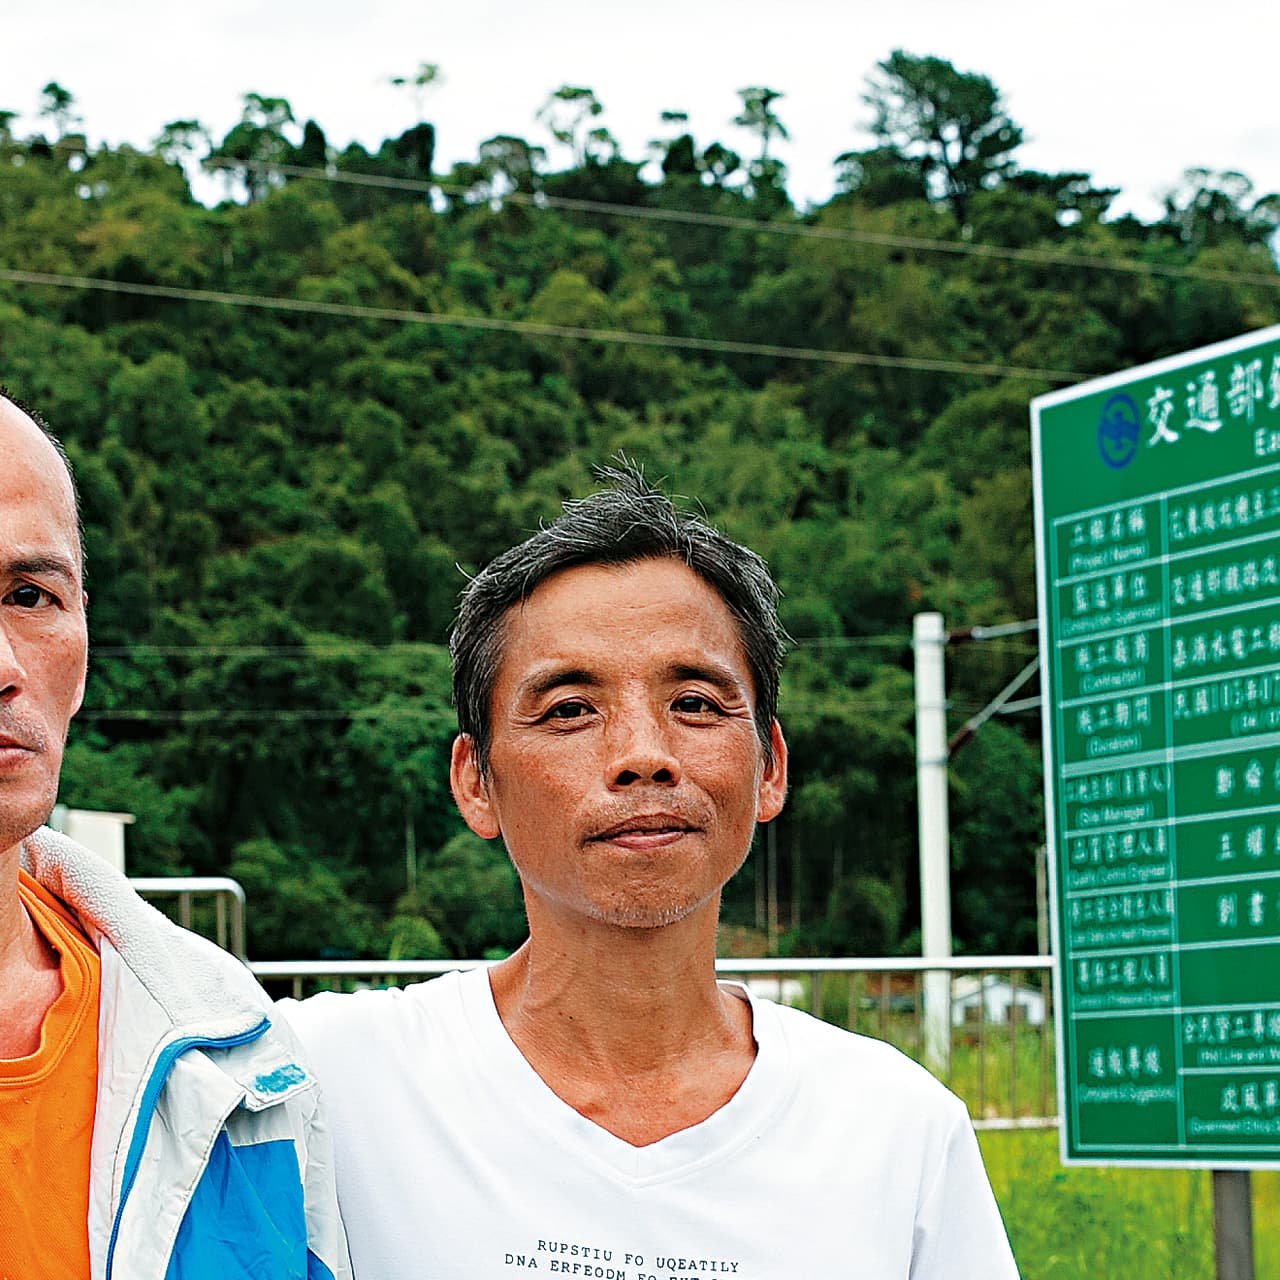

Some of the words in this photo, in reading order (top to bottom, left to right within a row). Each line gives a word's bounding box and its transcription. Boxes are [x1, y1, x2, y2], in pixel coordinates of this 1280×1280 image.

[504, 1253, 538, 1269] DNA
[537, 1239, 613, 1262] RUPSTIU
[624, 1253, 644, 1267] FO
[655, 1257, 739, 1273] UQEATILY
